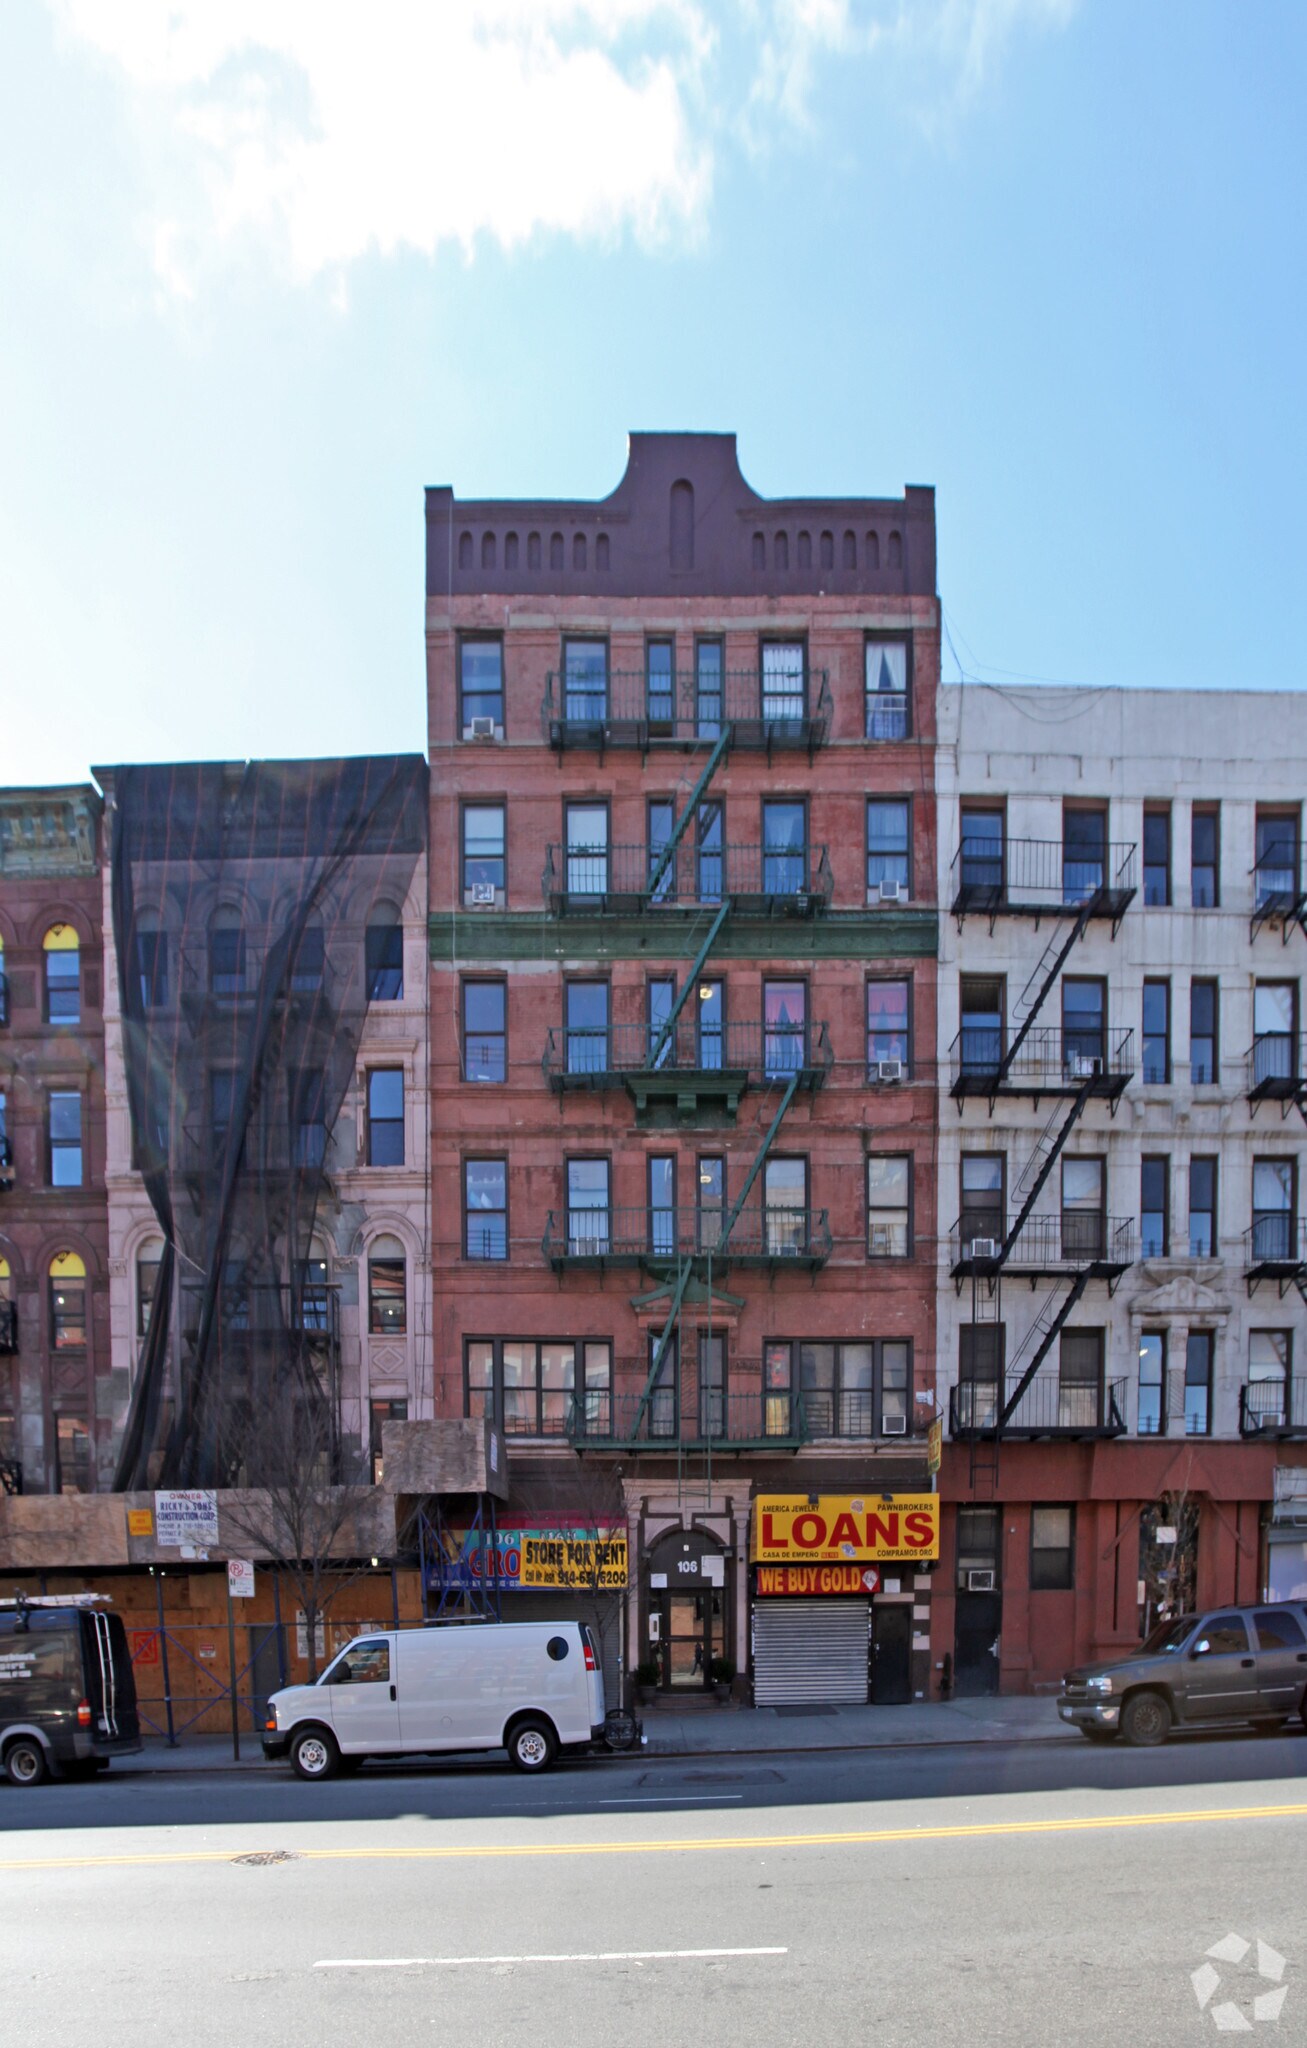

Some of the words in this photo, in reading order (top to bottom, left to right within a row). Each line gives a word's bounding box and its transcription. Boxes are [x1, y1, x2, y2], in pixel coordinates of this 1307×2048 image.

[160, 1502, 182, 1511] RICKY
[193, 1502, 213, 1511] SONS
[157, 1512, 198, 1521] CONSTRUCTION
[762, 1512, 934, 1549] LOANS
[526, 1541, 564, 1565] STORE
[567, 1543, 592, 1565] FOR
[595, 1543, 626, 1565] RENT
[792, 1550, 819, 1558] EMPEÑO
[877, 1549, 918, 1557] COMPRAMOS
[677, 1560, 698, 1573] 106
[760, 1568, 784, 1592] WE
[788, 1568, 818, 1592] BUY
[821, 1567, 861, 1592] GOLD
